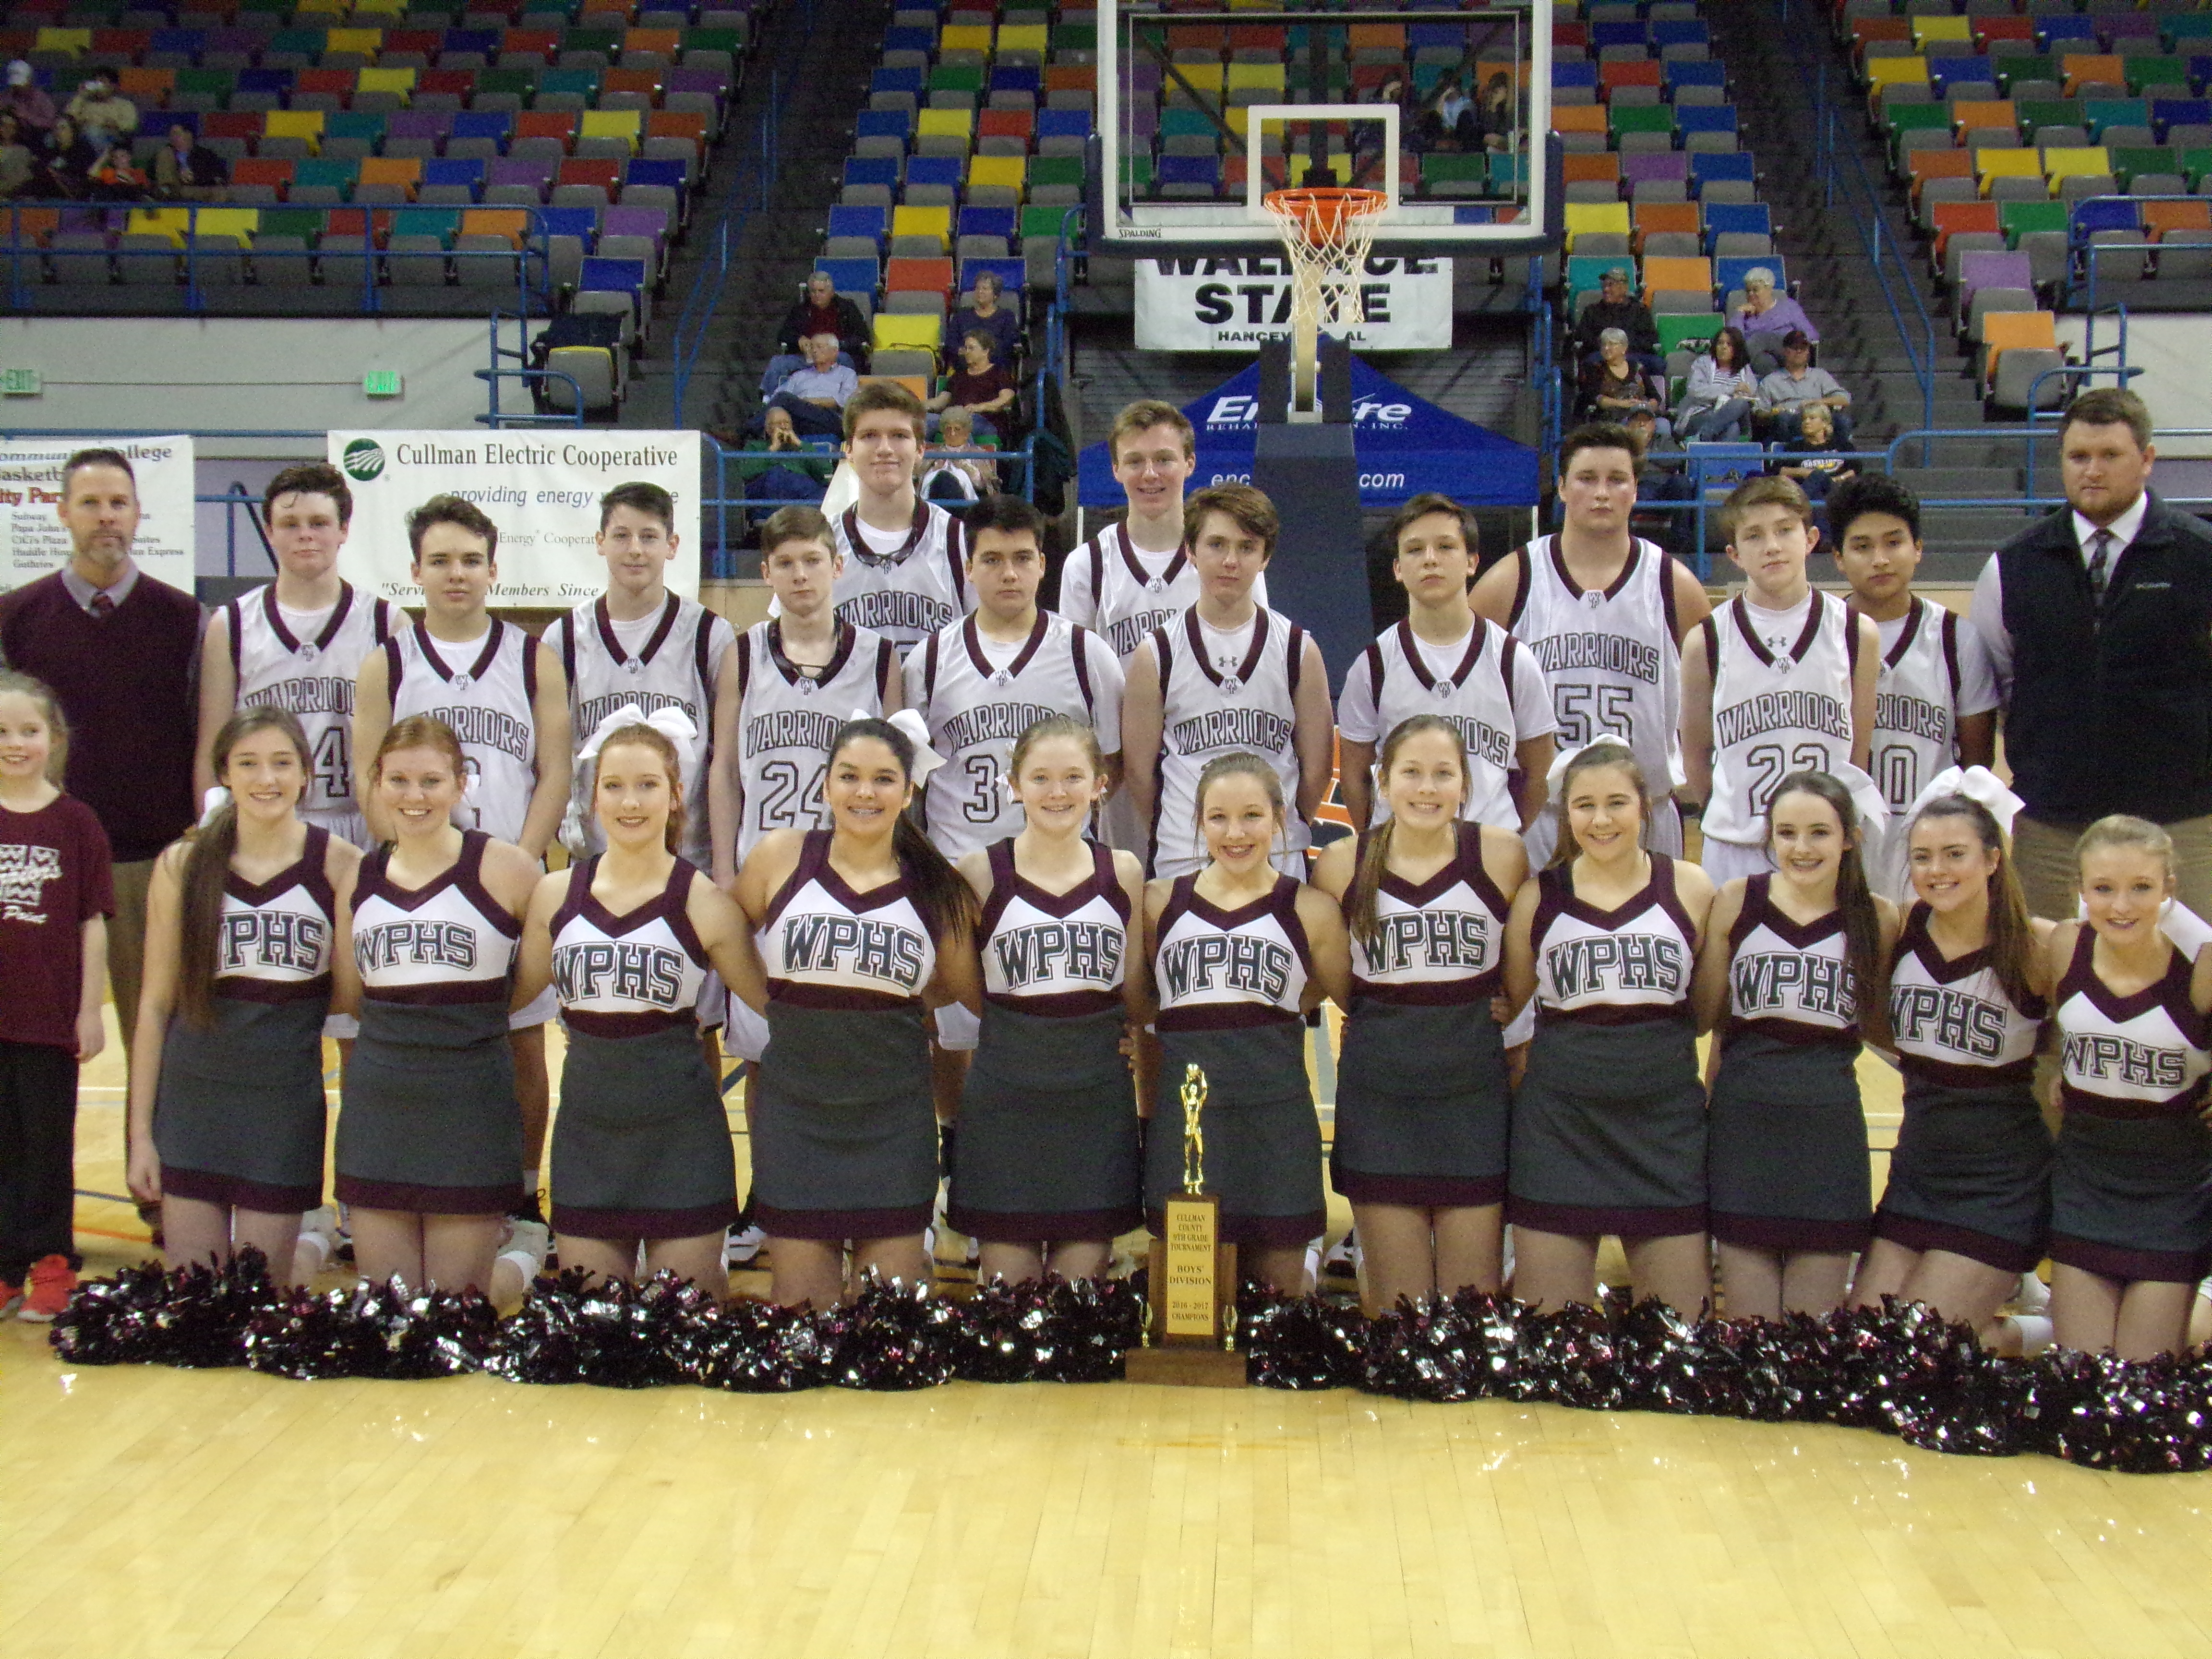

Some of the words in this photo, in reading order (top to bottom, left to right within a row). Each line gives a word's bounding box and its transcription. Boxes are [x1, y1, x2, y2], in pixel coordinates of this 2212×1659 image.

[1119, 228, 1161, 238] SPALDING
[397, 443, 477, 464] Cullman
[485, 443, 556, 464] Electric
[563, 444, 677, 471] Cooperative
[537, 490, 593, 507] energy
[557, 582, 599, 597] Since
[1528, 632, 1659, 685] WARRIORS
[746, 709, 850, 759] WARRIO
[1174, 707, 1292, 756] WARRIORS
[1554, 683, 1633, 751] 55
[1717, 690, 1851, 749] WARRIORS
[759, 760, 830, 831] 24
[218, 909, 325, 974] PHS
[354, 919, 477, 977] WPHS
[783, 913, 924, 992] WPHS
[993, 921, 1124, 990] WPHS
[1161, 933, 1293, 1003] WPHS
[1361, 909, 1488, 976] WPHS
[1547, 933, 1683, 1002] WPHS
[553, 940, 684, 1008] WPHS
[2064, 1031, 2187, 1089] WPHS
[1171, 1243, 1211, 1252] TOURNAMENT
[1178, 1224, 1202, 1232] COUNTY
[1169, 1276, 1211, 1285] DIVISION
[1171, 1313, 1209, 1321] CHAMPIONS
